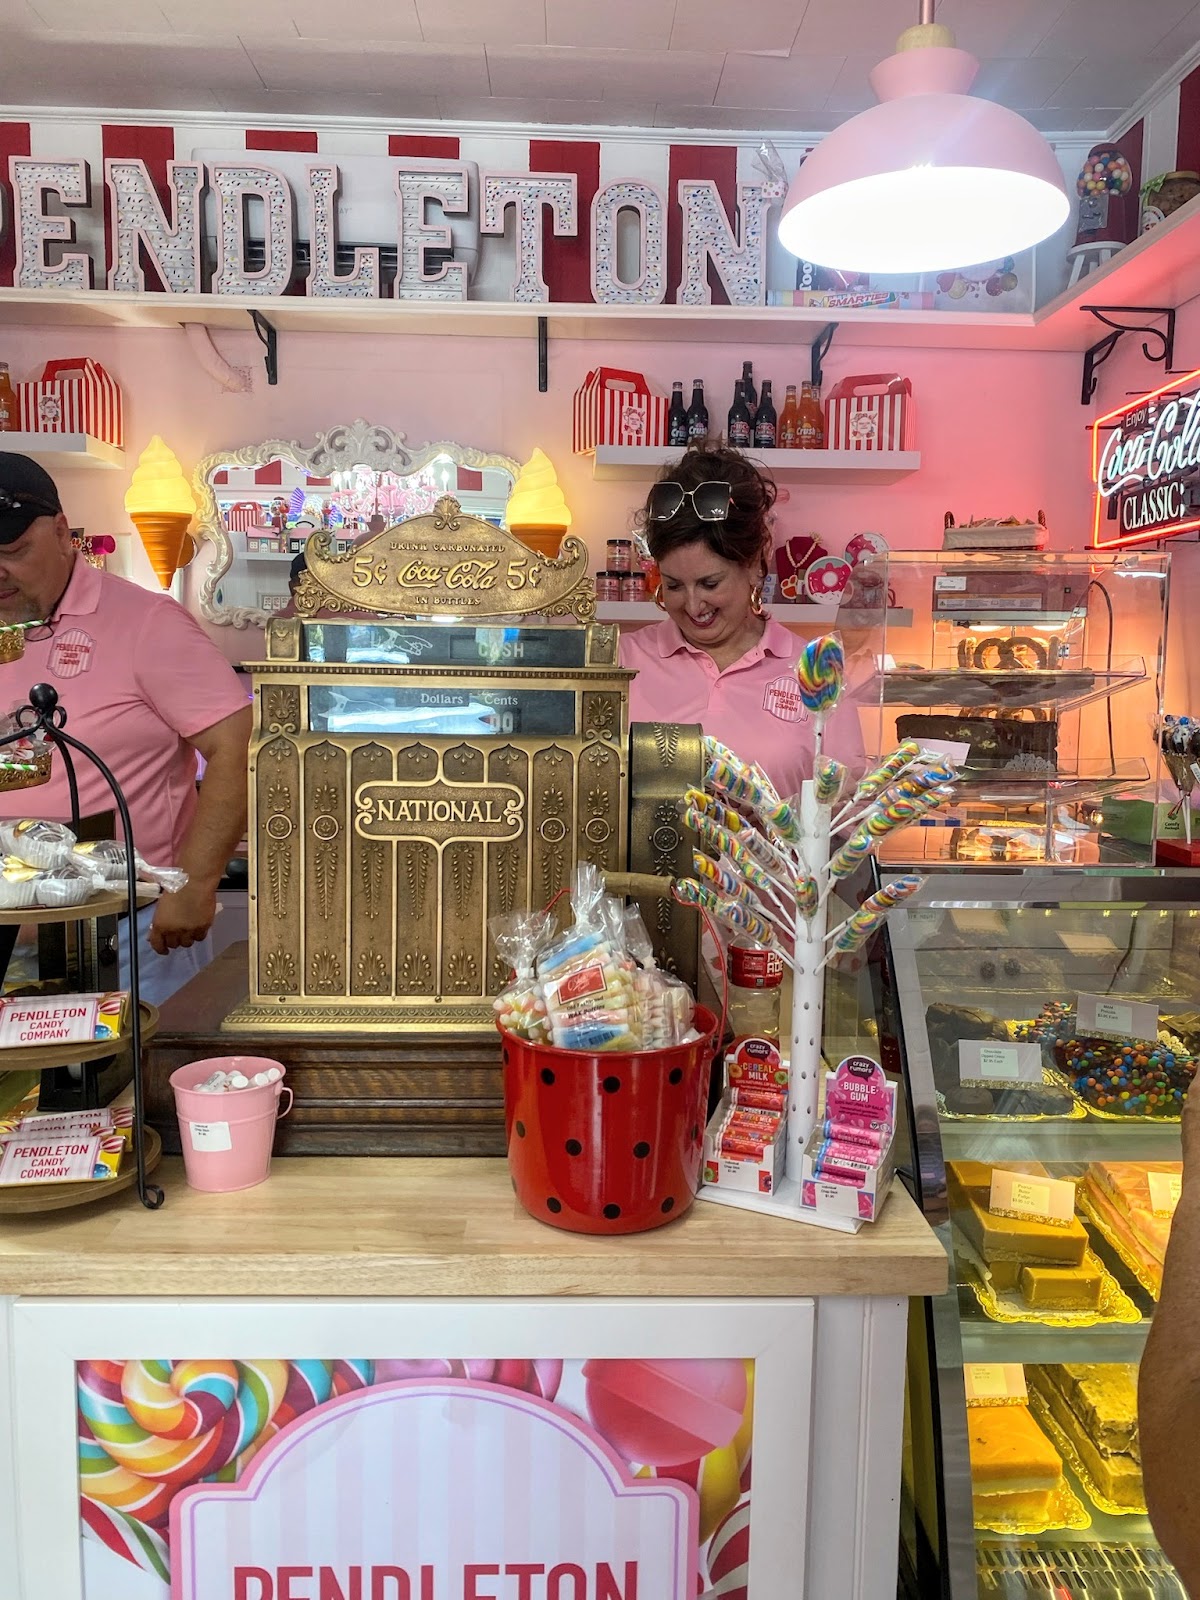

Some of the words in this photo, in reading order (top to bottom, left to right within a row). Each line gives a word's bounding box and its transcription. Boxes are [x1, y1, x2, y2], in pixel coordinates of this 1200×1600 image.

[0, 156, 769, 306] ENDLETON
[828, 291, 889, 308] SMARTIES
[1125, 407, 1148, 428] Enjoy
[796, 427, 816, 436] Crush
[1123, 481, 1179, 531] CLASSIC
[390, 541, 428, 551] DRINK
[433, 542, 506, 553] CARBONATED
[397, 559, 500, 590] Coca-Cola
[415, 596, 428, 605] IN
[433, 596, 481, 606] BOTTLES
[478, 641, 524, 658] CASH
[420, 693, 464, 704] Dollars
[484, 695, 519, 706] Cents
[769, 689, 802, 702] PENDLETO
[376, 800, 502, 824] NATIONAL
[10, 1007, 87, 1022] PENDLETON
[30, 1020, 64, 1030] CANDY
[20, 1029, 70, 1041] COMPANY
[742, 1062, 774, 1074] CEREAL
[852, 1060, 870, 1069] crazy
[748, 1071, 769, 1081] MILK
[843, 1081, 877, 1095] BUBBLE
[850, 1091, 869, 1103] GUM
[13, 1144, 89, 1158] PENDLETON
[31, 1157, 65, 1167] CANDY
[20, 1167, 70, 1179] COMPANY
[233, 1561, 639, 1600] PENDLETON
